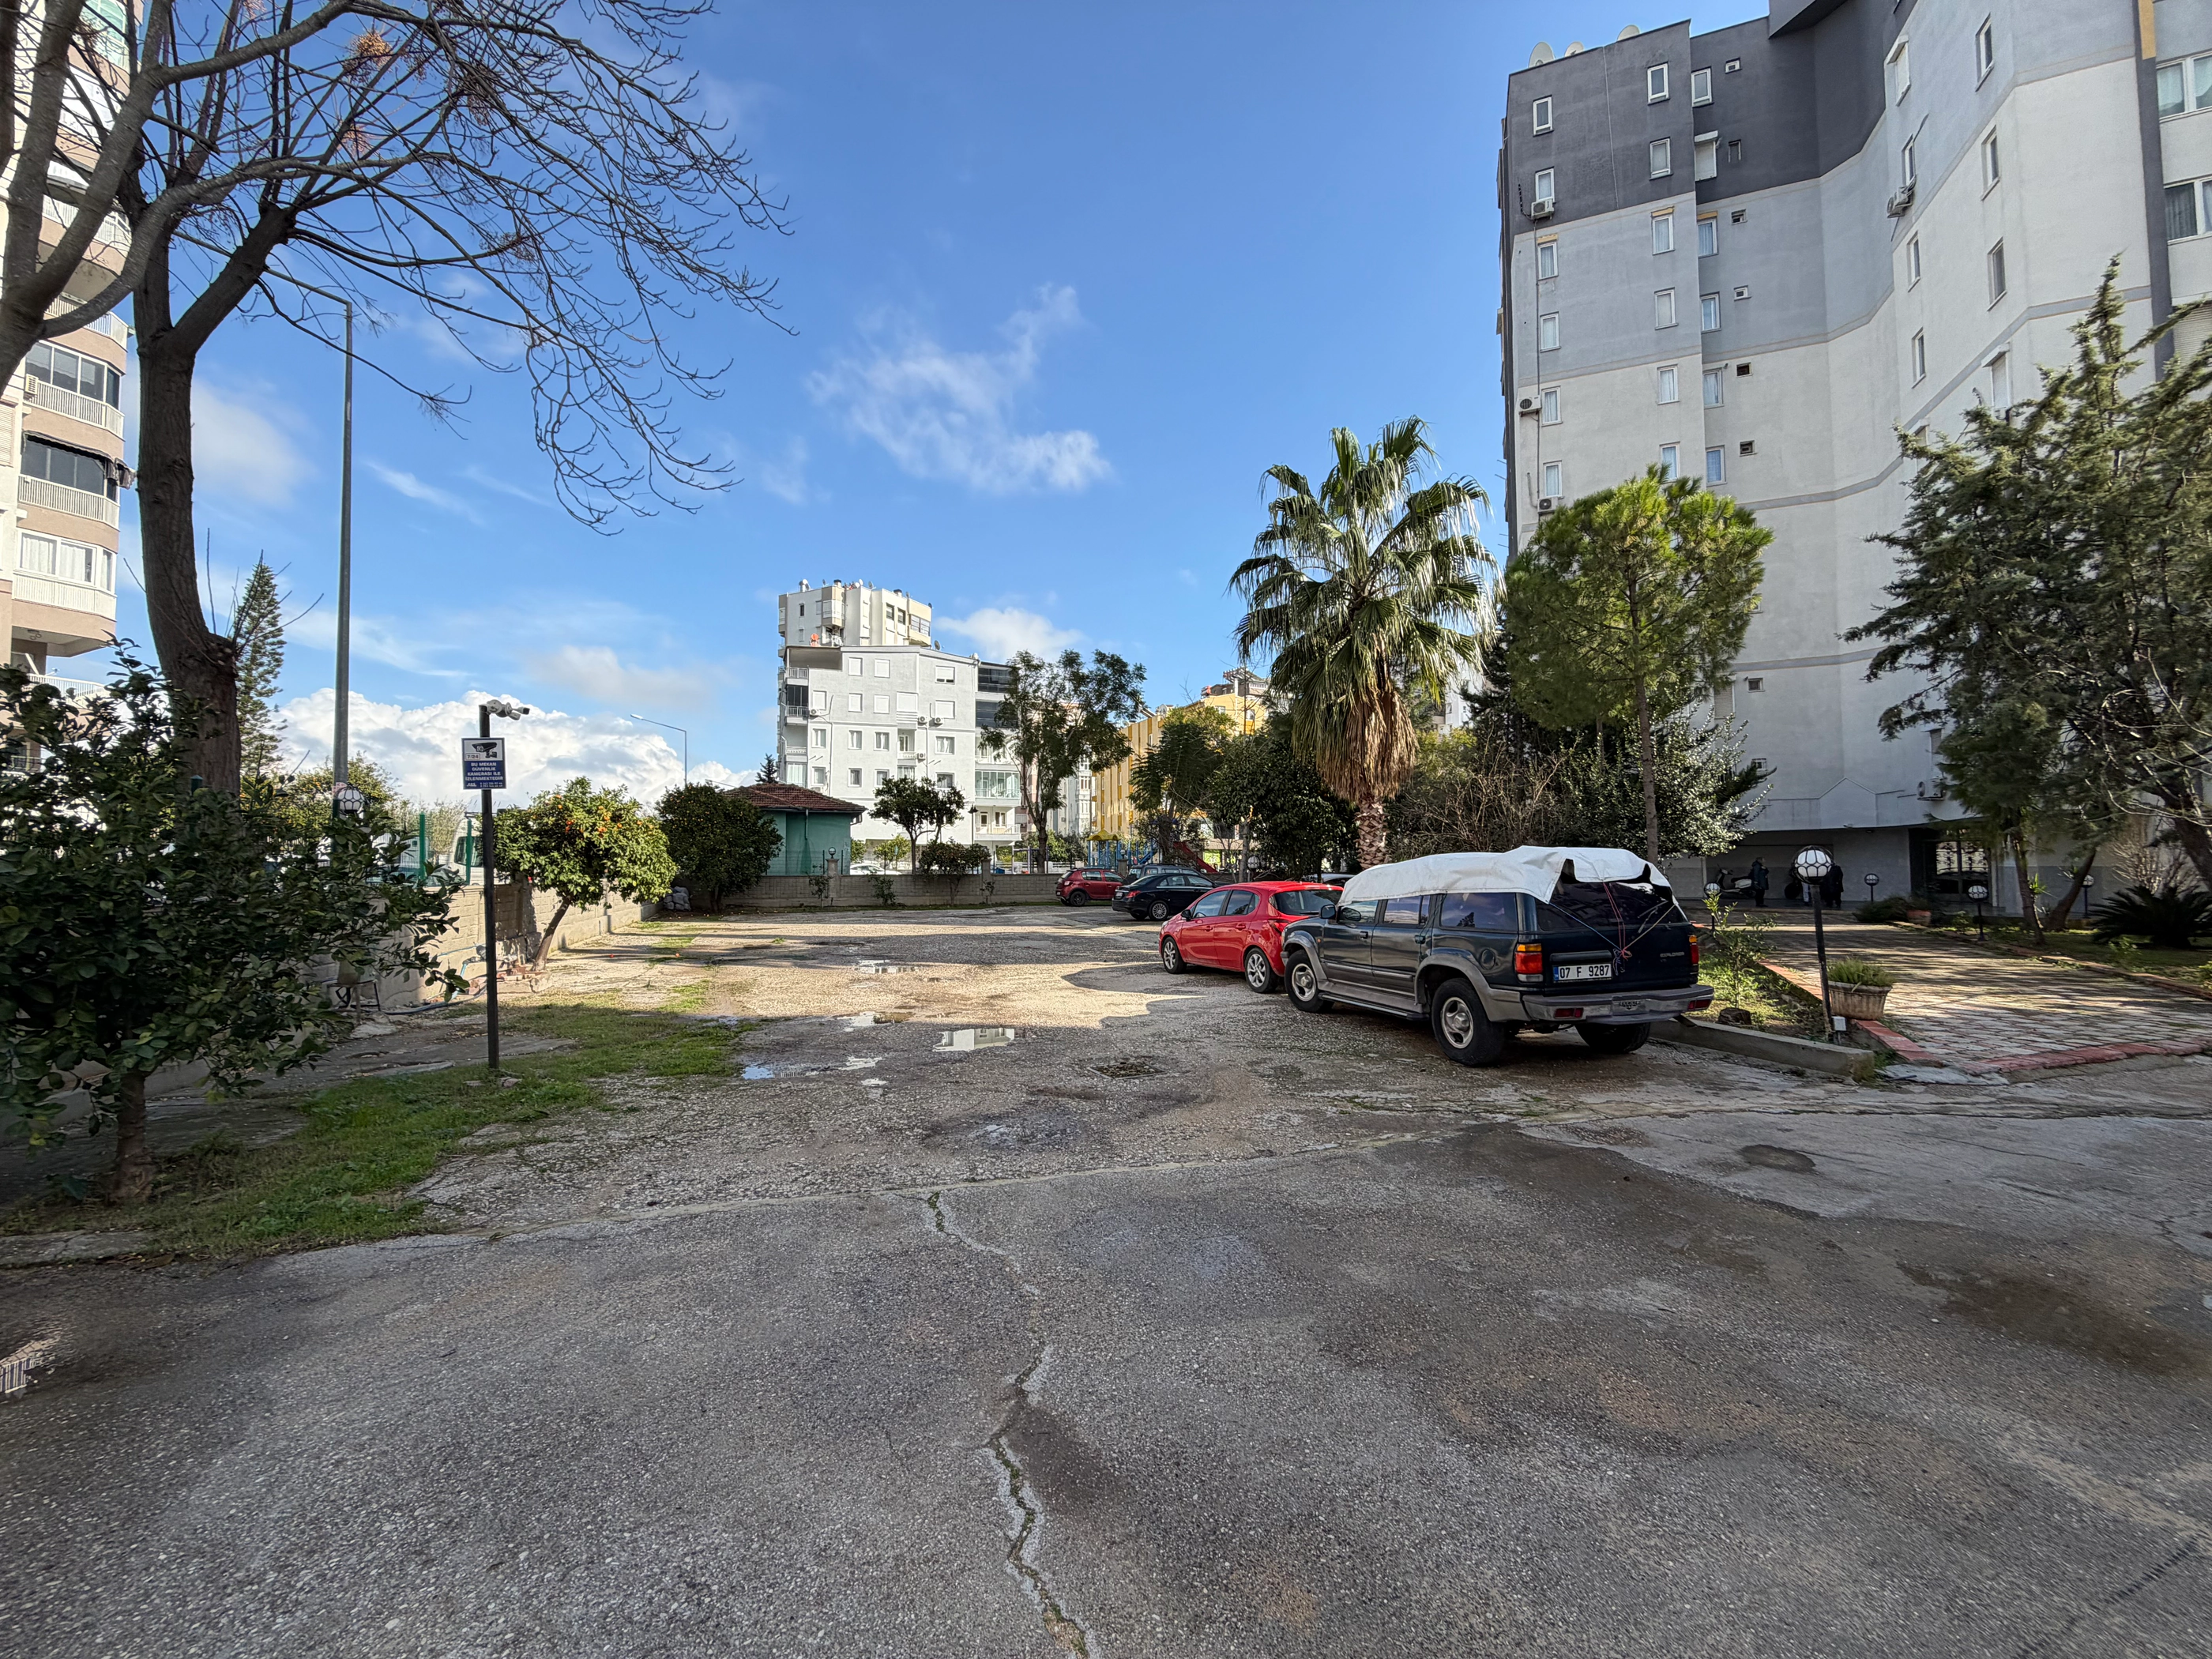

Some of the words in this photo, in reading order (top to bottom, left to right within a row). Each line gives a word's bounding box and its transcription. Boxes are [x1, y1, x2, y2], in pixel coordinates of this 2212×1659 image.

[1559, 967, 1571, 979] 07
[1576, 966, 1582, 978] F
[1589, 965, 1610, 976] 9287
